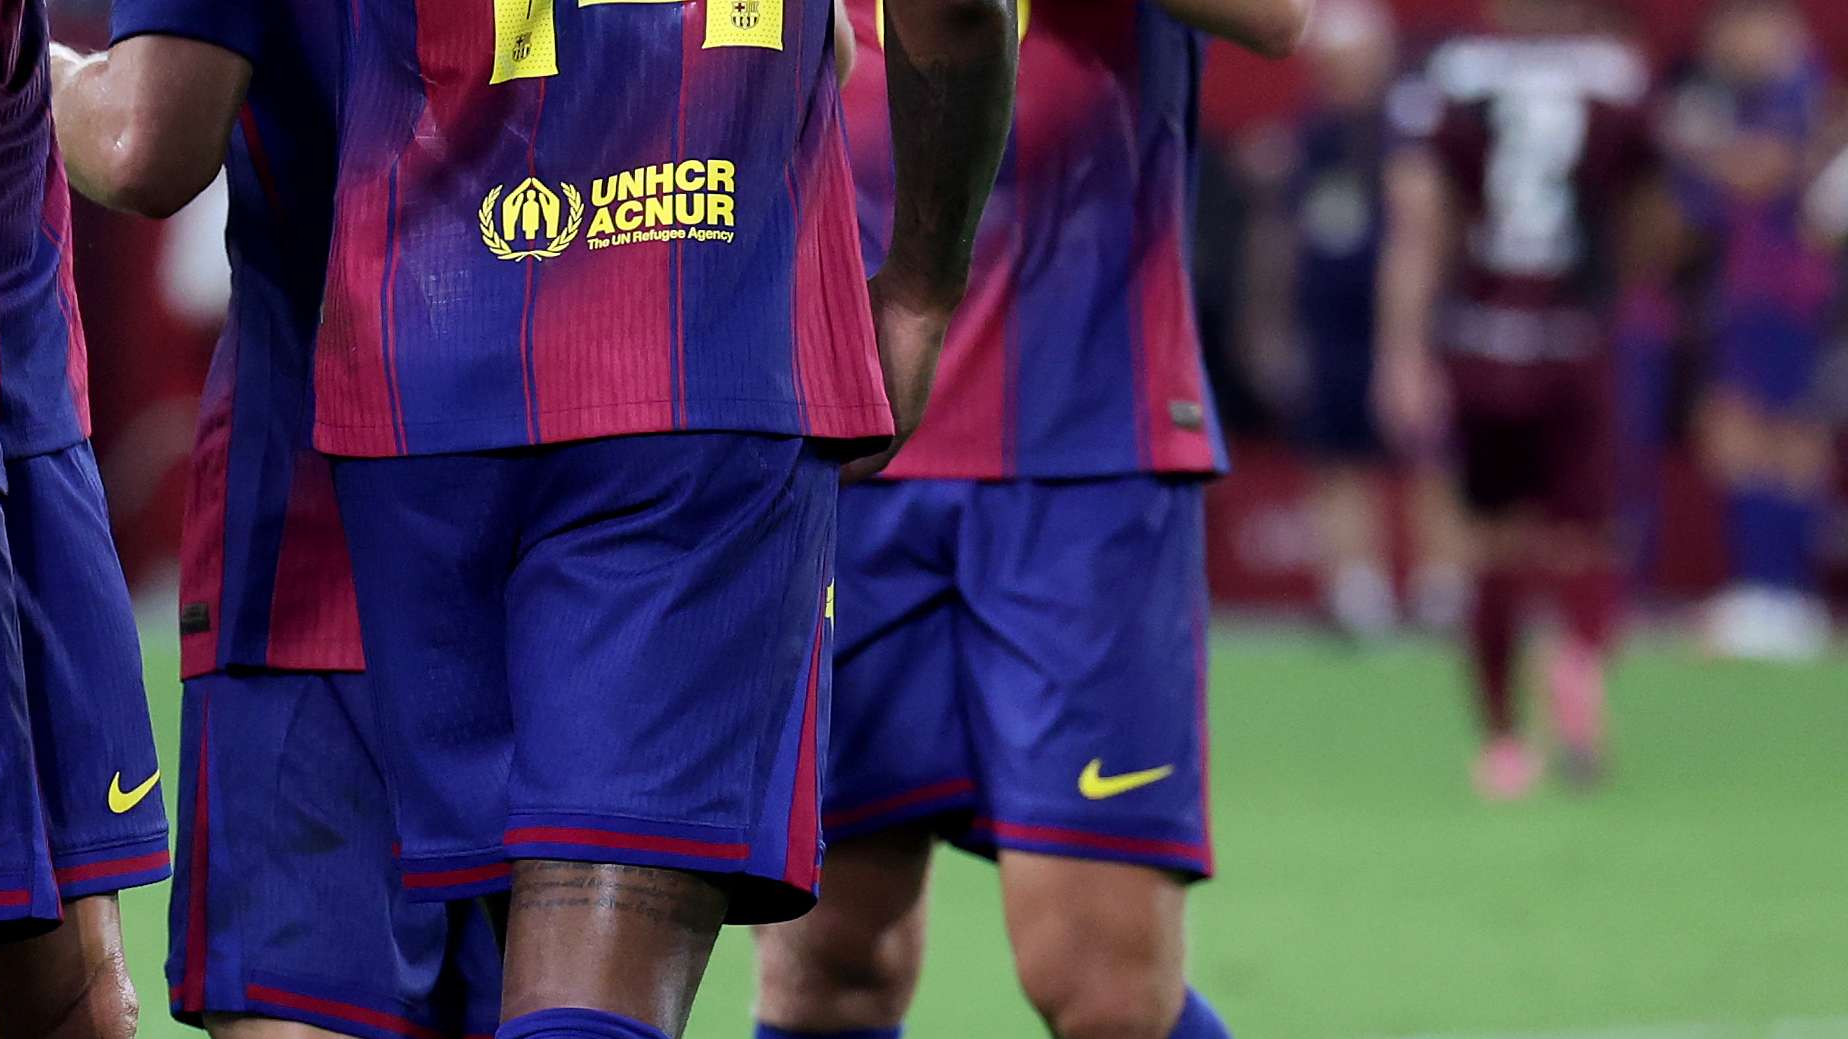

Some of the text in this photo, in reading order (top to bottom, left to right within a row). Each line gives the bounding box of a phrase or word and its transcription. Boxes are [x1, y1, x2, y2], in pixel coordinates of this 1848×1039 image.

[591, 159, 735, 207] UNHCR
[586, 192, 735, 238] ACNUR
[587, 226, 735, 250] The UN Refugee Agency
